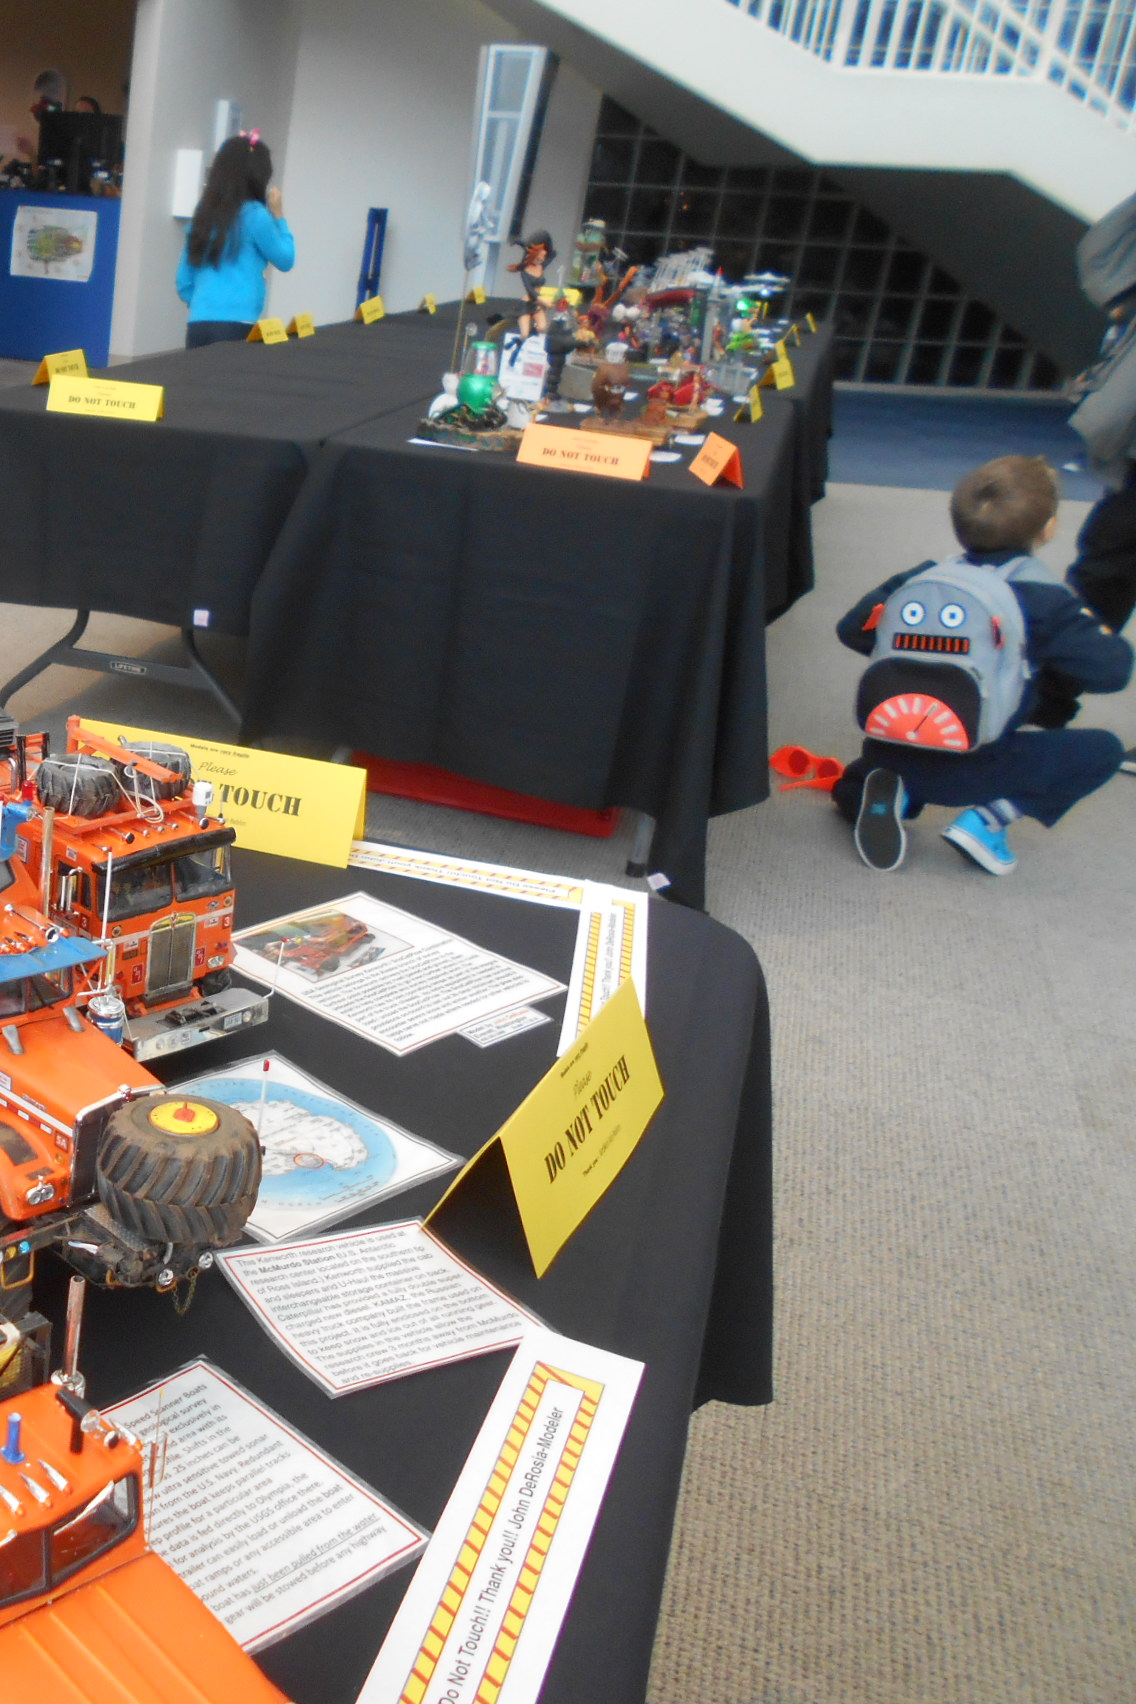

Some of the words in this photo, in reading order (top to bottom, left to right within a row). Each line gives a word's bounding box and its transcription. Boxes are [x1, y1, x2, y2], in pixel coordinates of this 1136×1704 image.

[68, 395, 82, 404] DO
[84, 397, 102, 406] NOT
[105, 399, 136, 409] TOUCH
[542, 447, 556, 457] DO
[561, 449, 581, 460] NOT
[584, 453, 619, 465] TOUCH
[198, 761, 238, 776] Please
[219, 783, 302, 817] TOUCH
[224, 916, 230, 927] 3
[544, 1142, 566, 1184] DO
[565, 1104, 593, 1157] NOT
[590, 1055, 630, 1121] TOUCH
[257, 1261, 302, 1273] McMurdo
[301, 1254, 335, 1264] Station
[178, 1397, 208, 1415] survey
[181, 1383, 207, 1398] Boats
[168, 1408, 212, 1434] exclusively
[177, 1430, 197, 1442] area
[195, 1419, 216, 1432] with
[182, 1438, 208, 1454] Shifts
[183, 1449, 213, 1467] inches
[520, 1405, 563, 1497] DeRosia-Modeler
[159, 1494, 183, 1510] from
[236, 1440, 283, 1467] Redundant
[160, 1480, 182, 1495] ultra
[181, 1460, 219, 1483] sensitive
[217, 1446, 246, 1463] towed
[243, 1433, 269, 1448] sonar
[188, 1495, 210, 1509] boat
[208, 1482, 236, 1499] keeps
[233, 1465, 267, 1485] parallel
[263, 1450, 291, 1467] tracks
[161, 1520, 192, 1540] profile
[211, 1487, 253, 1513] particular
[167, 1537, 190, 1552] data
[211, 1506, 247, 1529] directly
[186, 1535, 224, 1559] analysis
[248, 1506, 276, 1523] USGS
[271, 1492, 299, 1510] office
[221, 1538, 249, 1556] easily
[277, 1504, 308, 1523] unload
[321, 1483, 343, 1497] boat
[509, 1498, 531, 1529] John
[203, 1563, 234, 1583] ramps
[258, 1523, 304, 1551] accessible
[330, 1493, 355, 1509] enter
[495, 1530, 521, 1562] you!!
[210, 1595, 233, 1611] boat
[288, 1548, 319, 1569] pulled
[350, 1512, 377, 1529] water
[223, 1608, 247, 1624] gear
[273, 1572, 308, 1594] stowed
[305, 1555, 336, 1575] before
[349, 1524, 389, 1550] highway
[479, 1564, 506, 1602] Thank
[459, 1605, 491, 1655] Touch!!
[449, 1660, 472, 1685] Not
